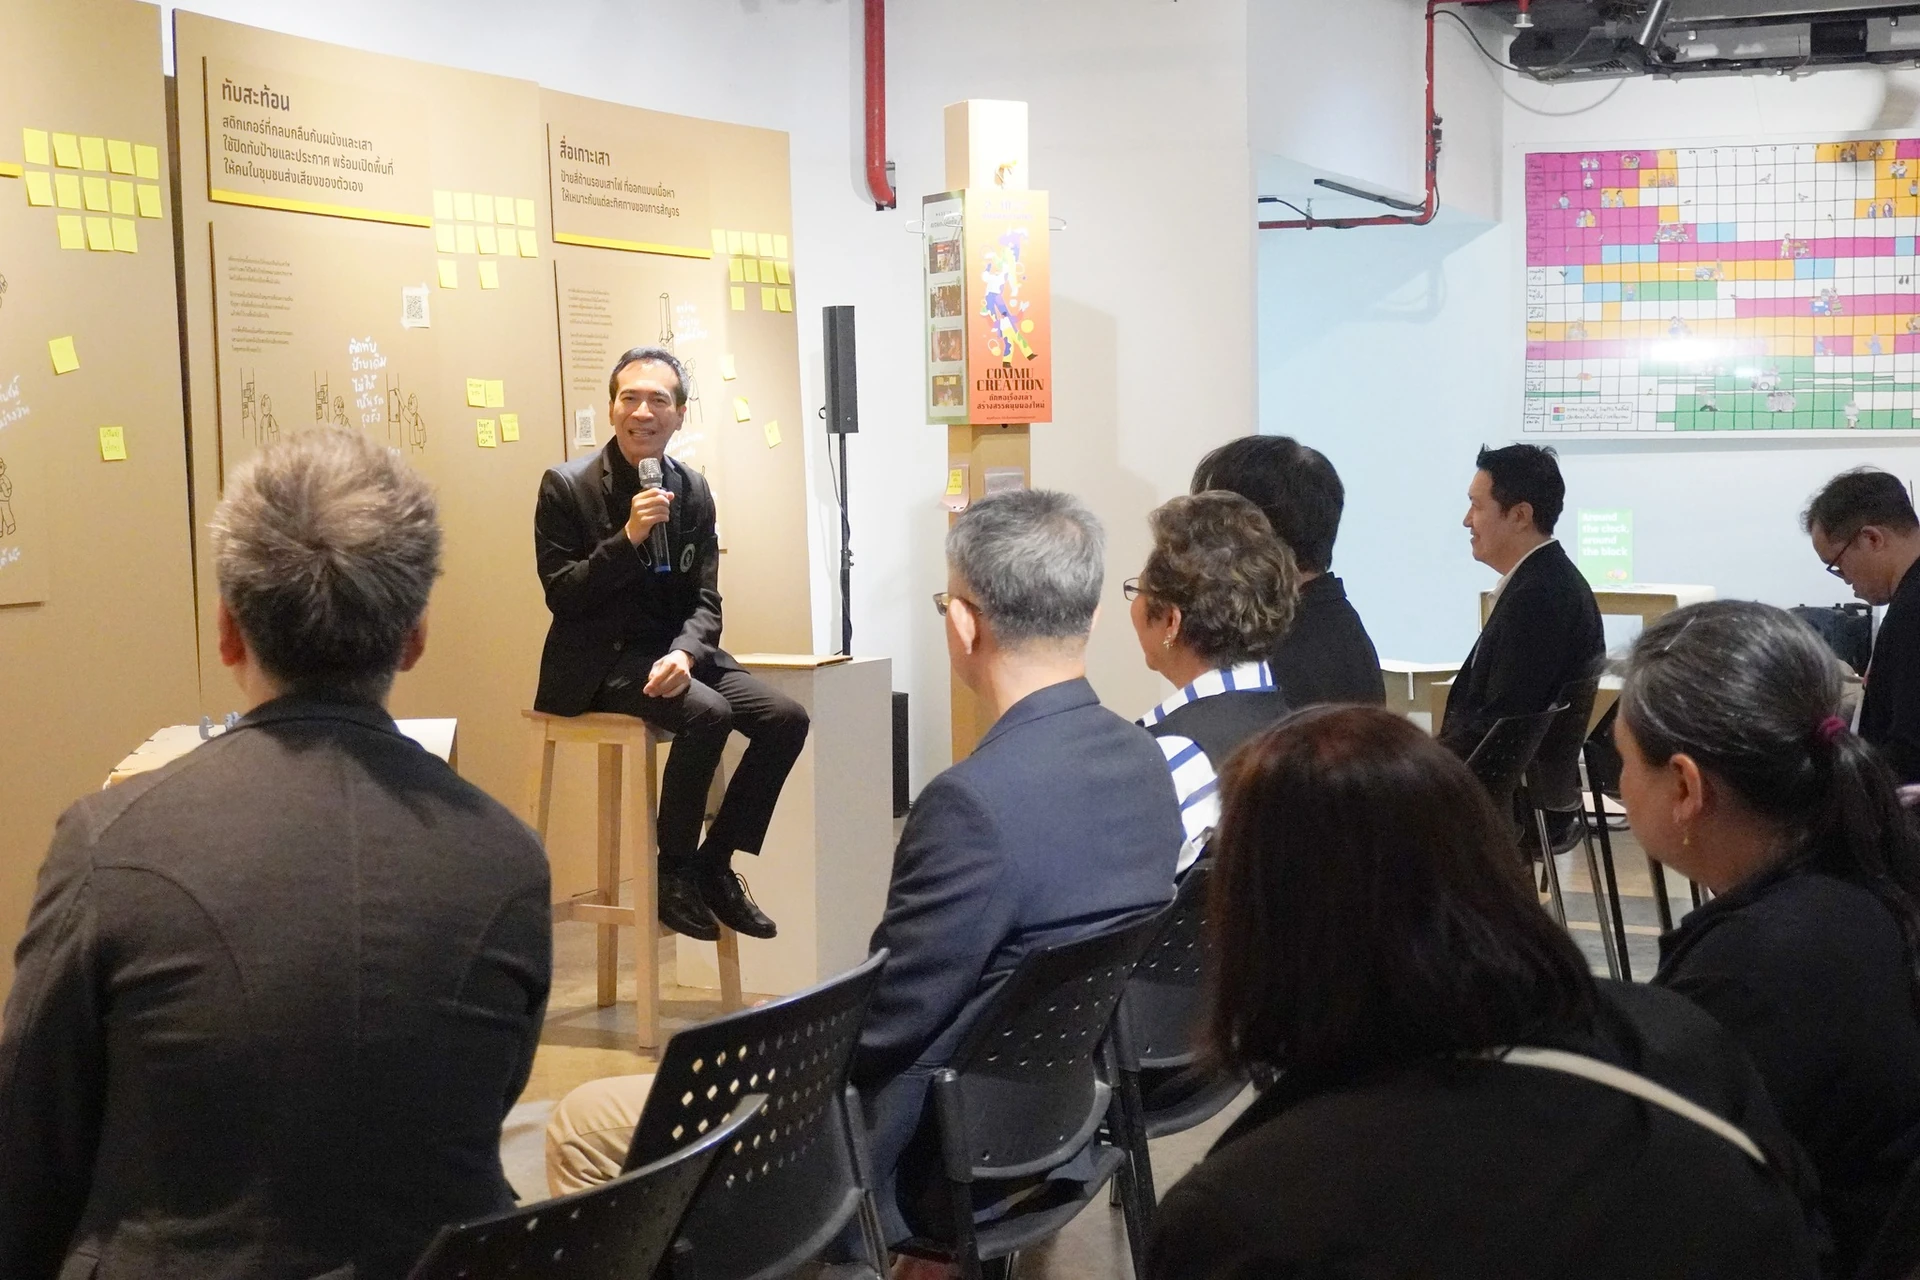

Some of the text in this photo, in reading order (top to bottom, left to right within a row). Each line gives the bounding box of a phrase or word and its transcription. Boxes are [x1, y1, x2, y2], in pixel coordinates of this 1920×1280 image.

[222, 78, 290, 111] ทับสะท้อน
[223, 135, 394, 176] ใช้ปิดทับป้ายและประกาศ พร้อมเปิดพื้นที่
[560, 135, 611, 166] สื่อเกาะเสา
[224, 158, 364, 192] ให้คนในชุมชนส่งเสียงของตัวเอง
[986, 368, 1034, 379] COMMU
[976, 379, 1045, 391] CREATION
[1582, 512, 1618, 522] Around
[1582, 524, 1599, 533] the
[1582, 536, 1617, 544] around
[1582, 547, 1628, 556] the block
